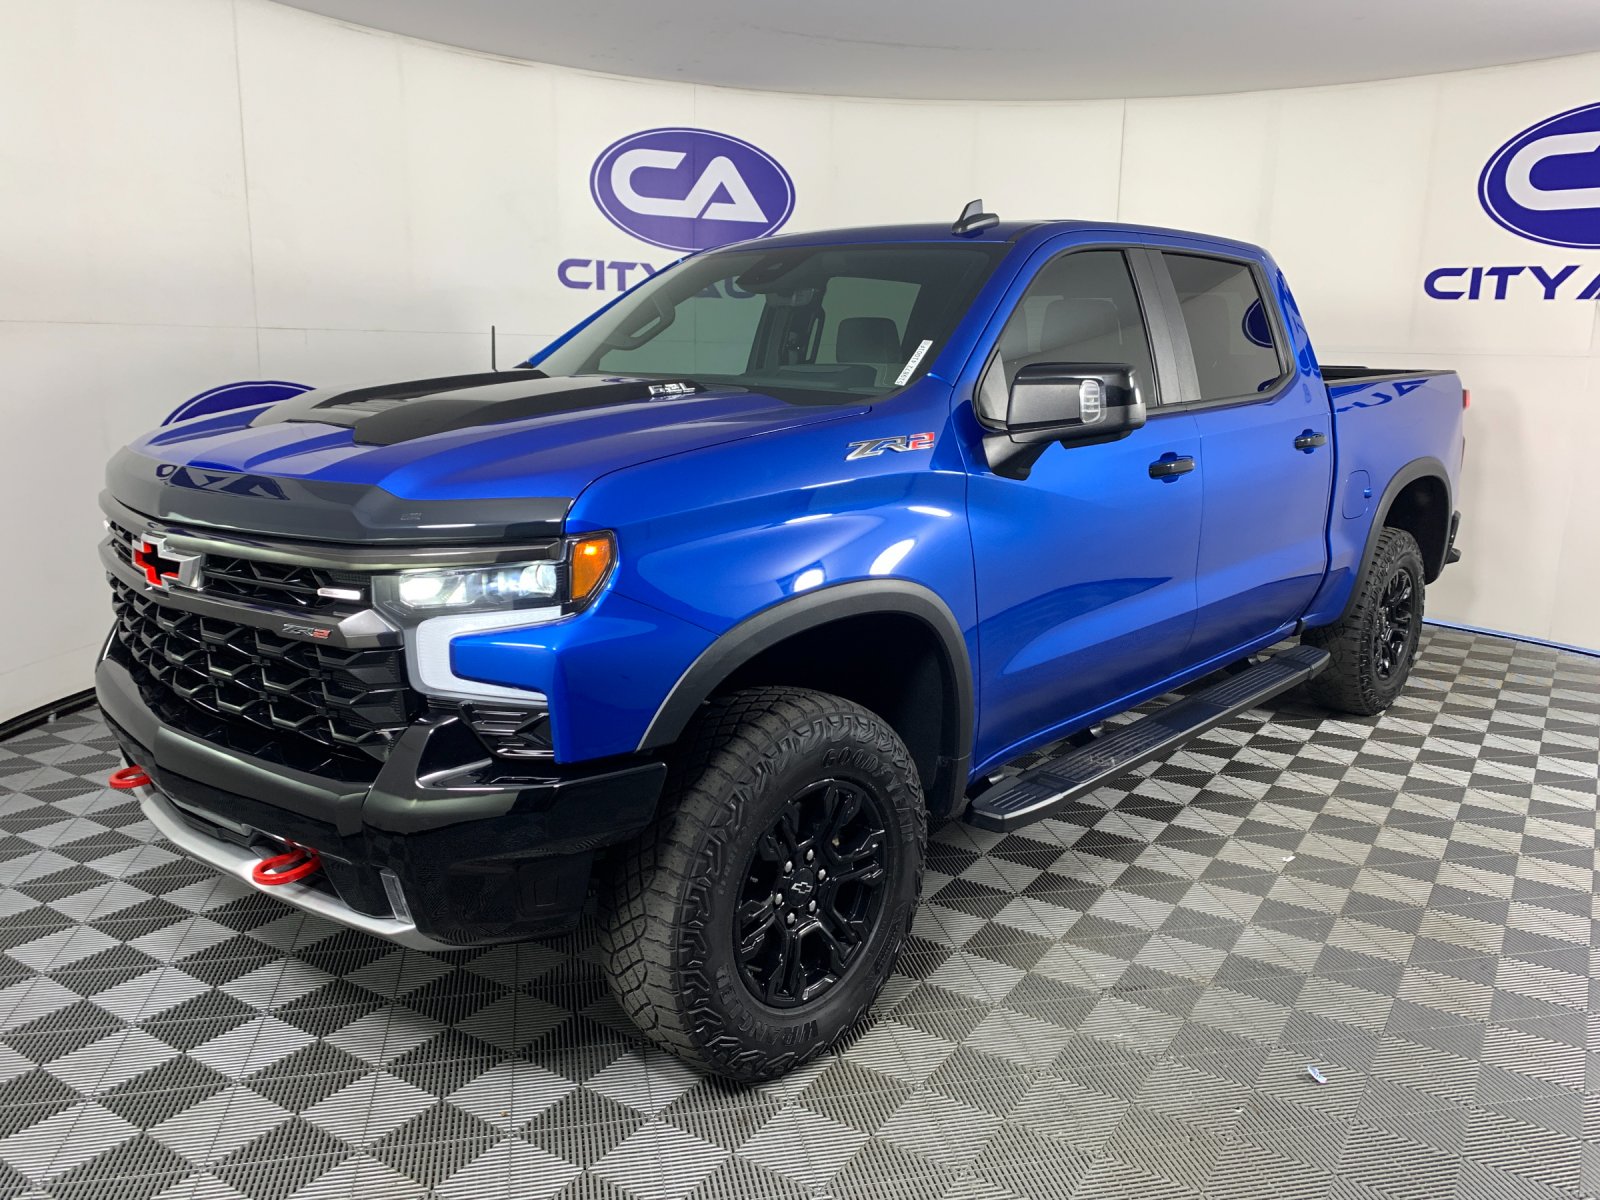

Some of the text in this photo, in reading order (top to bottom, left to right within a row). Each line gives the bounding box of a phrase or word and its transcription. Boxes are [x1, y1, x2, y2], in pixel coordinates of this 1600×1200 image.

[611, 148, 769, 223] CA
[1505, 130, 1600, 211] C
[1423, 264, 1581, 300] CITY
[845, 431, 935, 461] ZR2
[282, 623, 332, 640] ZR2
